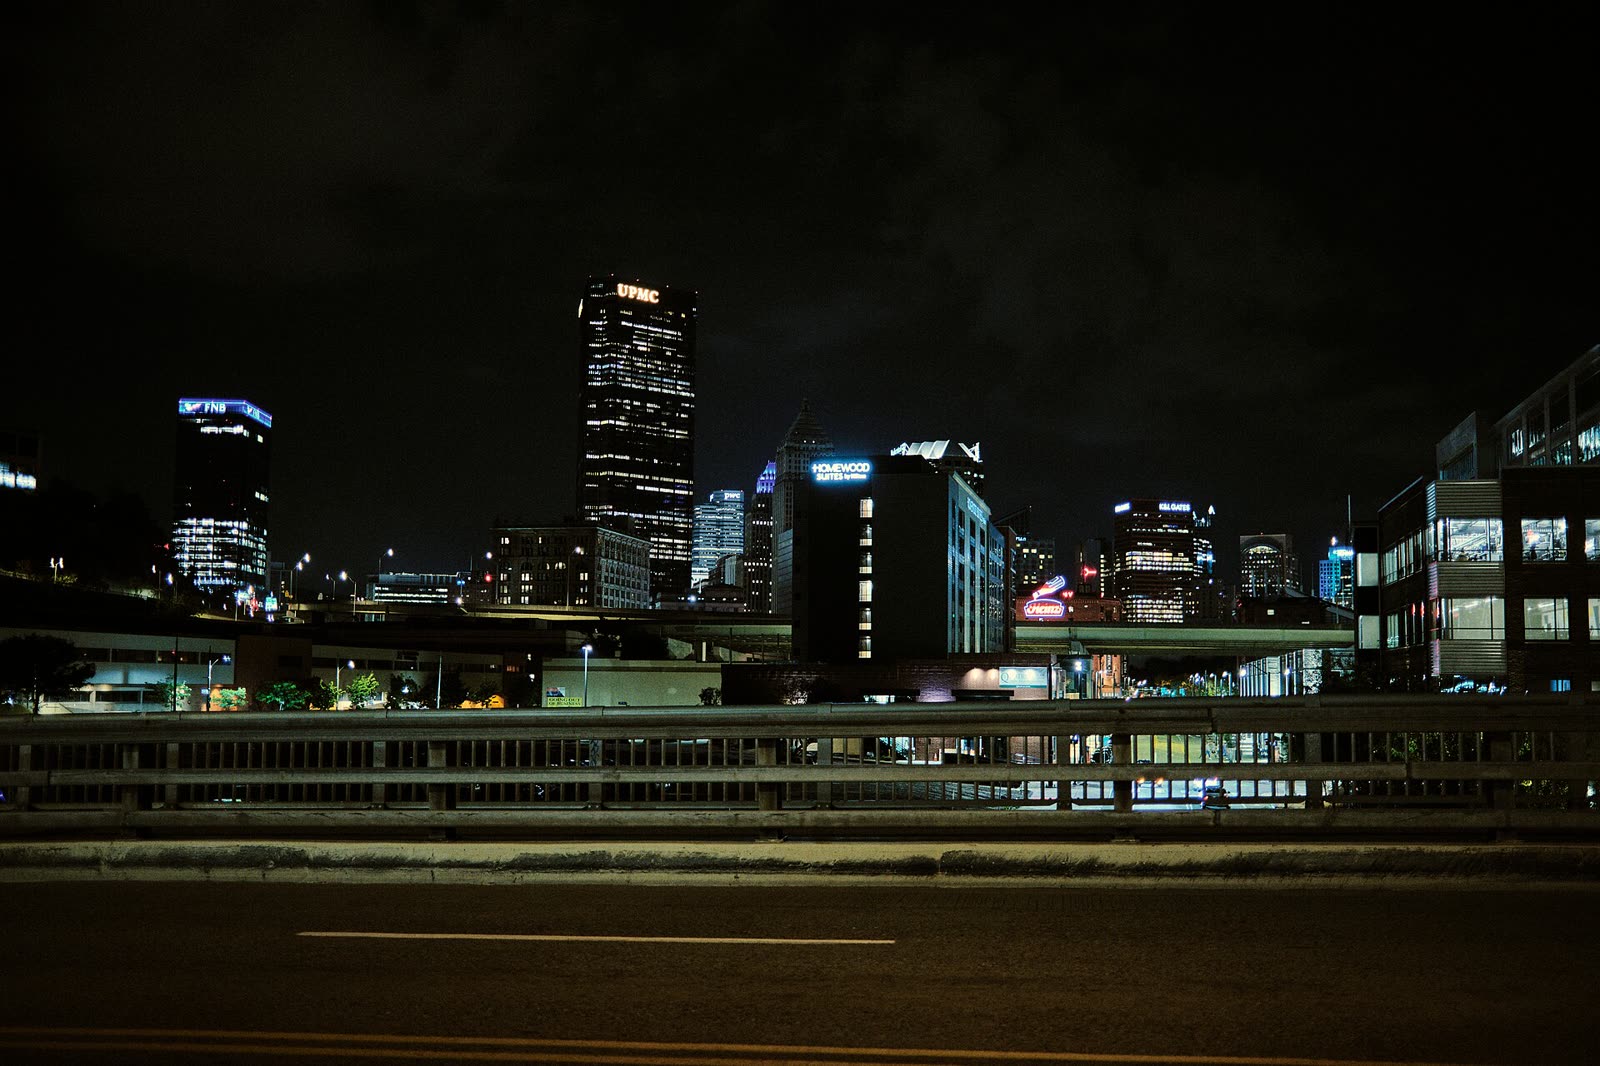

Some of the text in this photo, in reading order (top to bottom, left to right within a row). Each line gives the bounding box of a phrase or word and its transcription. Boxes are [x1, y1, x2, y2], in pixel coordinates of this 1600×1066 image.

[617, 283, 660, 304] UPMC
[204, 402, 227, 414] FNB
[812, 462, 870, 473] HOMEWOOD
[816, 472, 843, 481] SUITES
[724, 492, 741, 501] pwc
[1171, 503, 1191, 512] GATES
